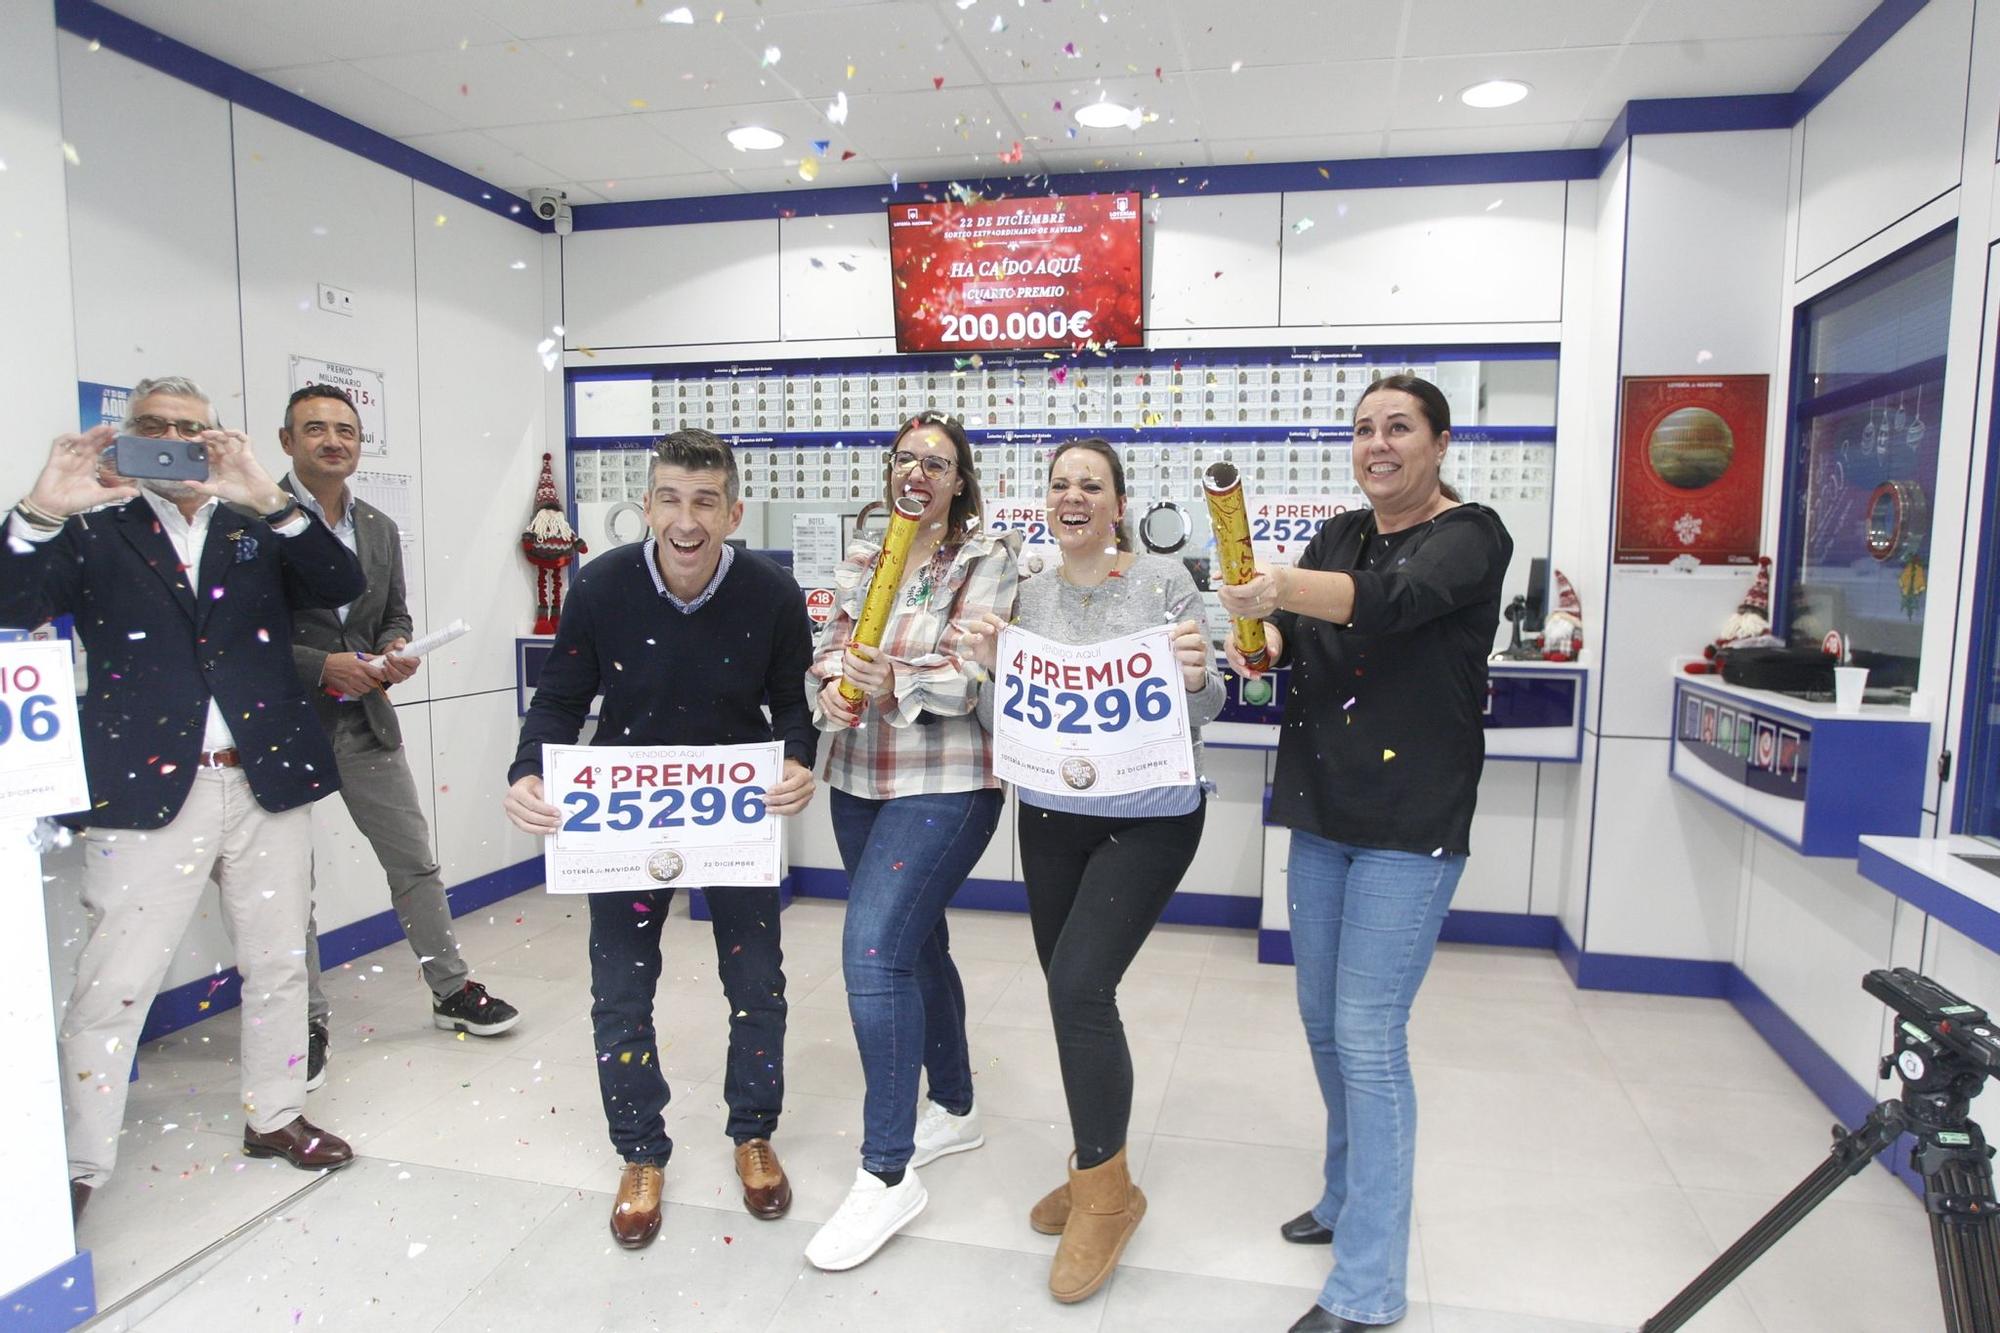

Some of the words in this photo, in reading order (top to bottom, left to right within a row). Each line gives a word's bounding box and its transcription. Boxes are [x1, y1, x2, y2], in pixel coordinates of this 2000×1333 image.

[959, 217, 973, 228] 22
[976, 216, 992, 227] DE
[996, 213, 1066, 226] DICIEMBRE
[944, 231, 972, 239] SORTEO
[1049, 225, 1084, 234] NAVIDAD
[950, 262, 974, 278] HA
[979, 257, 1033, 277] CAÍDO
[1034, 255, 1082, 276] AQUÍ
[966, 286, 1015, 300] CUARTO
[1016, 285, 1065, 299] PREMIO
[941, 310, 1094, 342] 200.000€
[326, 364, 353, 376] PREMIO
[319, 373, 361, 388] MILLONARIO
[1012, 508, 1045, 522] PRE
[1275, 504, 1347, 518] PREMIO
[812, 592, 830, 604] +18
[1031, 652, 1153, 691] PREMIO
[1003, 673, 1172, 735] 25296
[628, 750, 677, 759] VENDIDO
[1127, 760, 1169, 774] DICIEMBRE
[611, 762, 756, 789] PREMIO
[563, 785, 767, 832] 25296
[604, 865, 641, 873] NAVIDAD
[714, 860, 754, 868] DICIEMBRE
